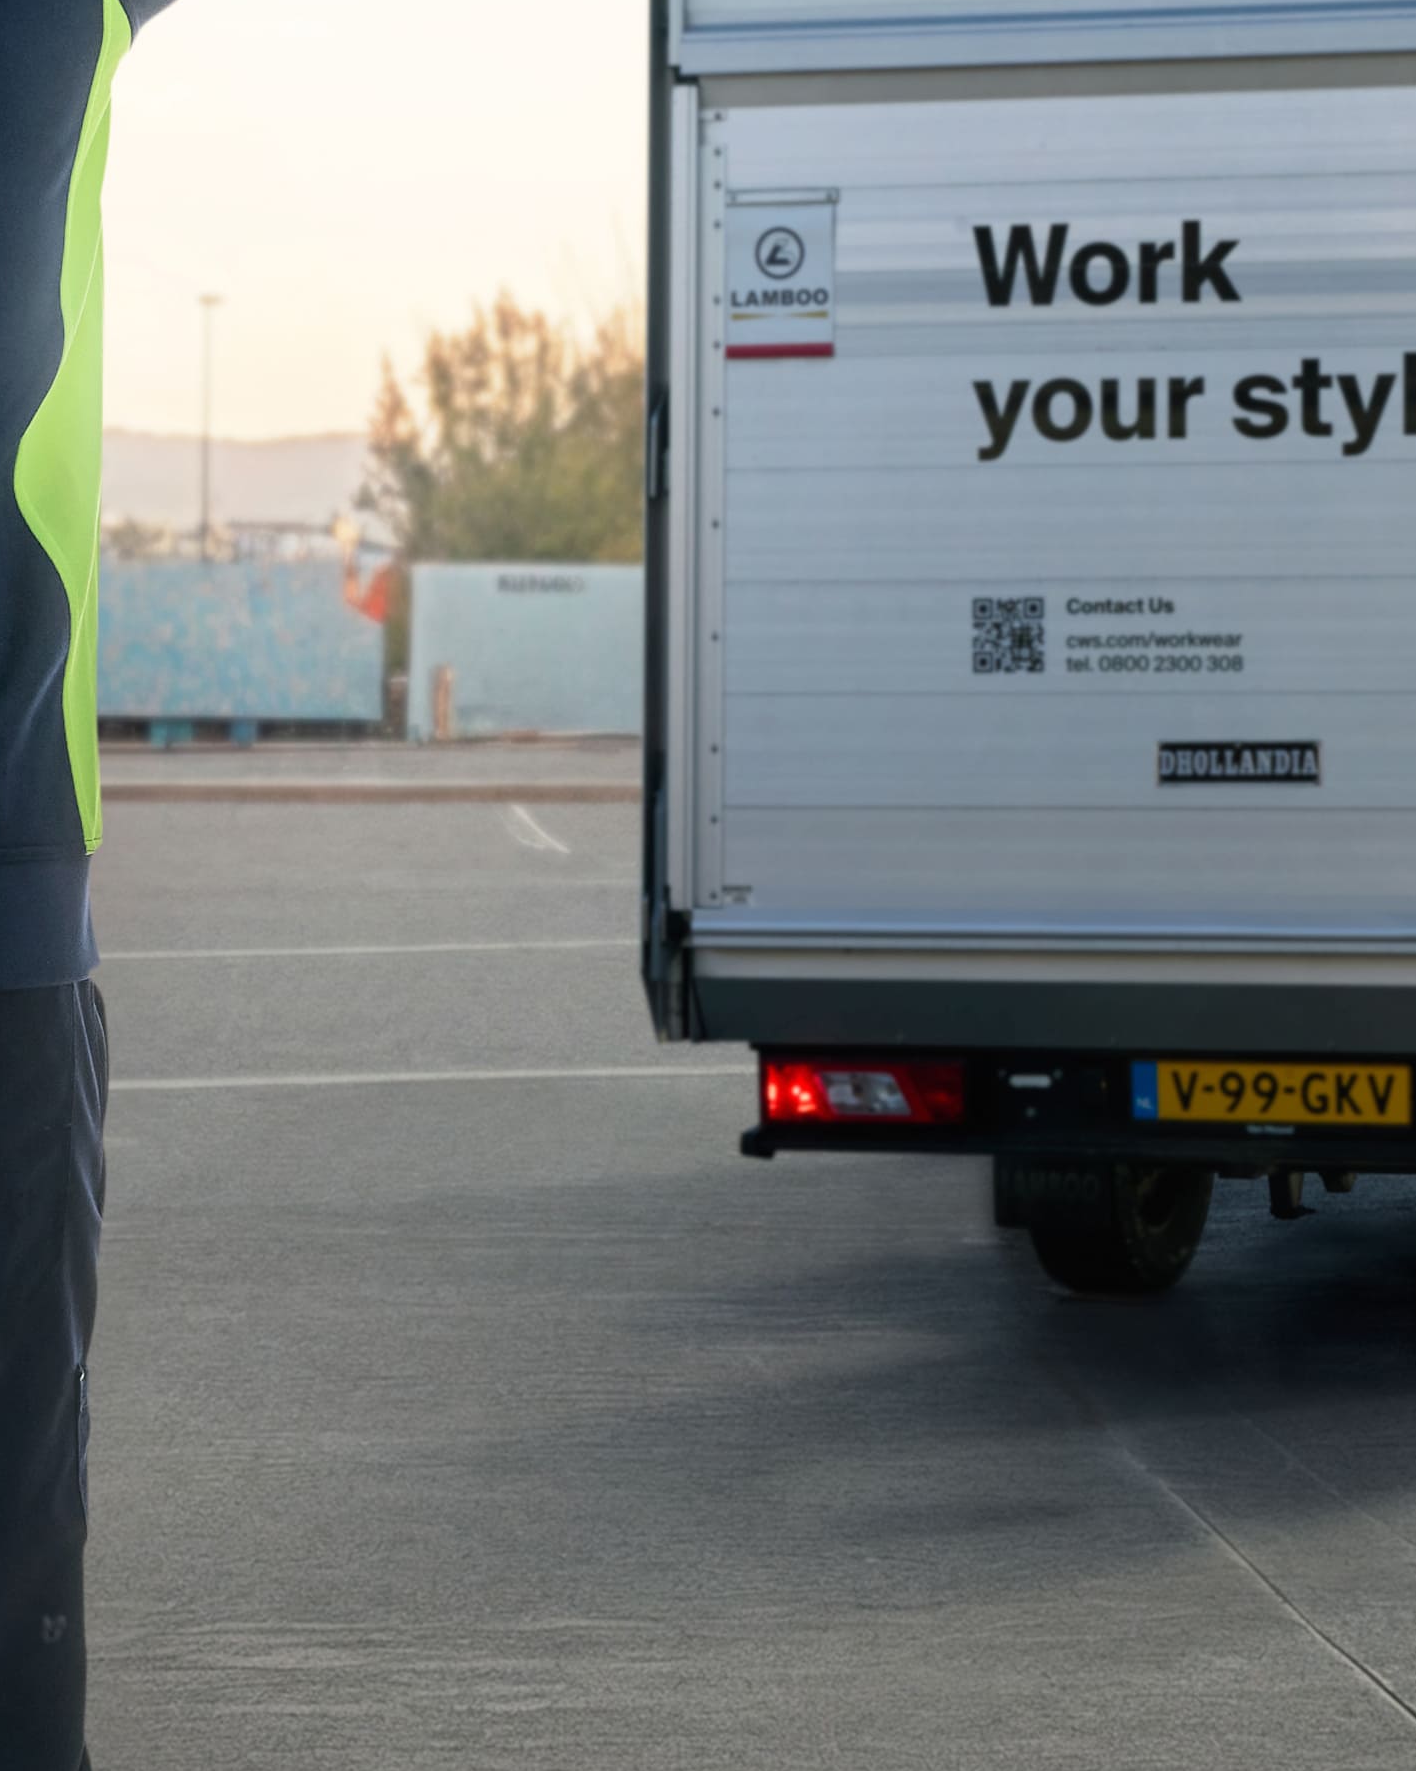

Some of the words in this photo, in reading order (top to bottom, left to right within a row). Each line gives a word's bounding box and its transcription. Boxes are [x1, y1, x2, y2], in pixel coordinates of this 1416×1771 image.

[973, 221, 1241, 307] Work
[731, 288, 829, 307] LAMBOO
[973, 376, 1204, 461] your
[1066, 597, 1144, 614] Contact
[1148, 597, 1175, 614] Us
[1066, 632, 1243, 651] cws.com/workwear
[1066, 655, 1093, 672] tel.
[1098, 655, 1150, 672] 0800
[1154, 655, 1202, 672] 2300
[1206, 655, 1244, 672] 308
[1160, 749, 1318, 775] DHOLLANDIA
[1171, 1070, 1394, 1115] V-99-GKV
